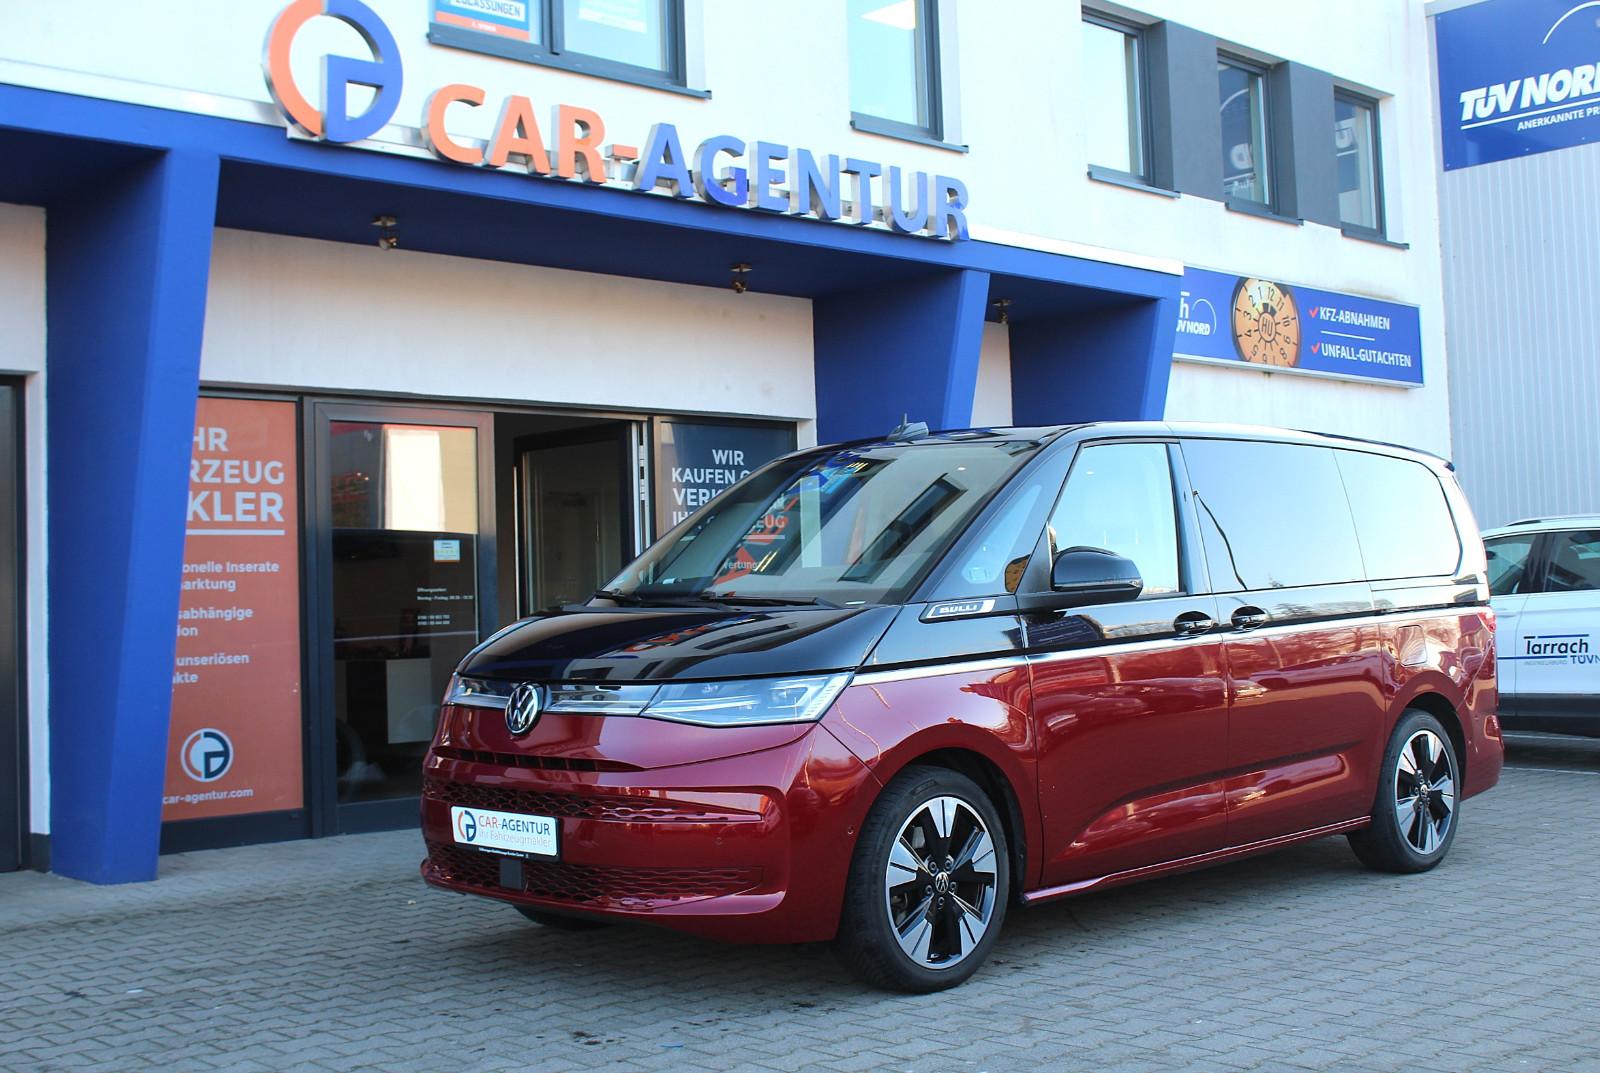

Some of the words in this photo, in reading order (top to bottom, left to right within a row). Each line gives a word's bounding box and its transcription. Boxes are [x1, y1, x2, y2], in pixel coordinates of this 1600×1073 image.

[1517, 109, 1585, 131] ANERKANNTE
[422, 83, 969, 241] CAR-AGENTUR
[1261, 317, 1274, 337] HU
[1319, 306, 1391, 331] KFZ-ABNAHMEN
[1186, 321, 1211, 336] NORD
[1321, 342, 1412, 368] UNFALL-GUTACHTEN
[712, 449, 745, 466] WIR
[671, 467, 736, 484] KAUFEN
[187, 490, 285, 522] KLER
[226, 560, 280, 573] Inserate
[181, 579, 237, 593] arktung
[939, 604, 977, 614] BULLI
[176, 652, 250, 667] unseriösen
[163, 788, 254, 805] car-agentur.com
[478, 815, 551, 836] CAR-AGENTUR
